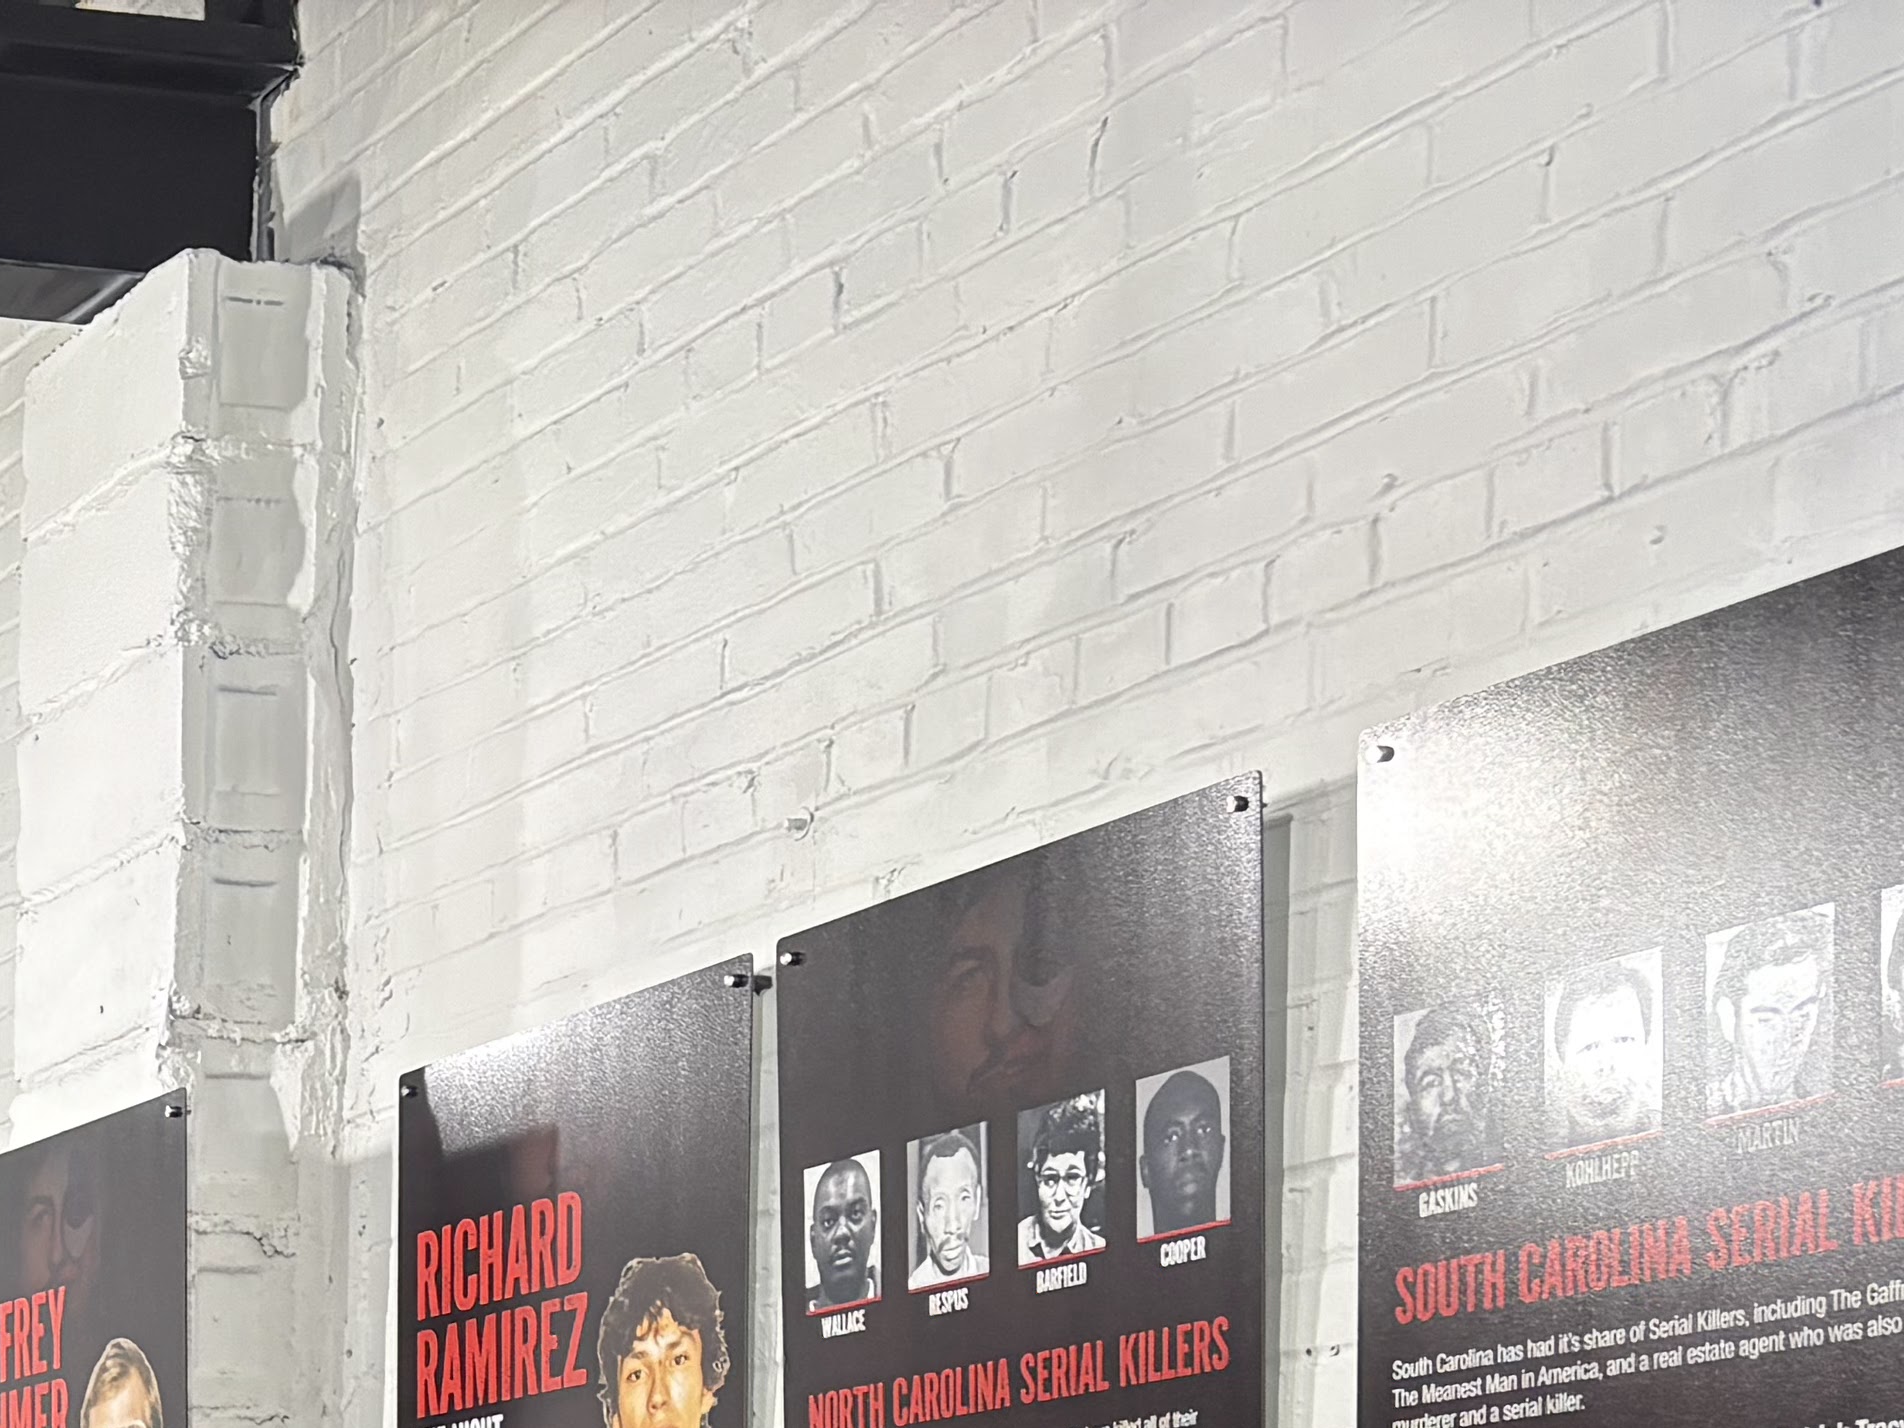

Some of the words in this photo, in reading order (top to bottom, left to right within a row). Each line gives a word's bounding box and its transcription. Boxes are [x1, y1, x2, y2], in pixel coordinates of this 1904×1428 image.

[1566, 1150, 1639, 1188] KOHLHEPP
[1419, 1182, 1478, 1218] GASKINS
[416, 1191, 582, 1321] RICHARD
[1160, 1236, 1207, 1268] COOPER
[1395, 1249, 1506, 1325] SOUTH
[1519, 1215, 1692, 1304] CAROLINA
[1705, 1187, 1839, 1271] SERIAL
[1036, 1261, 1087, 1294] BARFIELD
[929, 1287, 969, 1316] RESPUS
[821, 1309, 866, 1338] WALLACE
[1392, 1356, 1432, 1380] South
[1436, 1348, 1493, 1373] Carolina
[1497, 1343, 1523, 1363] has
[1527, 1335, 1554, 1359] had
[1558, 1332, 1581, 1355] it's
[1583, 1327, 1626, 1350] share
[1629, 1321, 1645, 1343] of
[1649, 1314, 1693, 1339] Serial
[1697, 1308, 1749, 1333] Killers,
[1753, 1295, 1826, 1323] including
[1829, 1289, 1861, 1312] The
[416, 1291, 588, 1419] RAMIREZ
[892, 1358, 1010, 1427] CAROLINA
[1020, 1340, 1109, 1404] SERIAL
[1119, 1315, 1230, 1388] KILLERS
